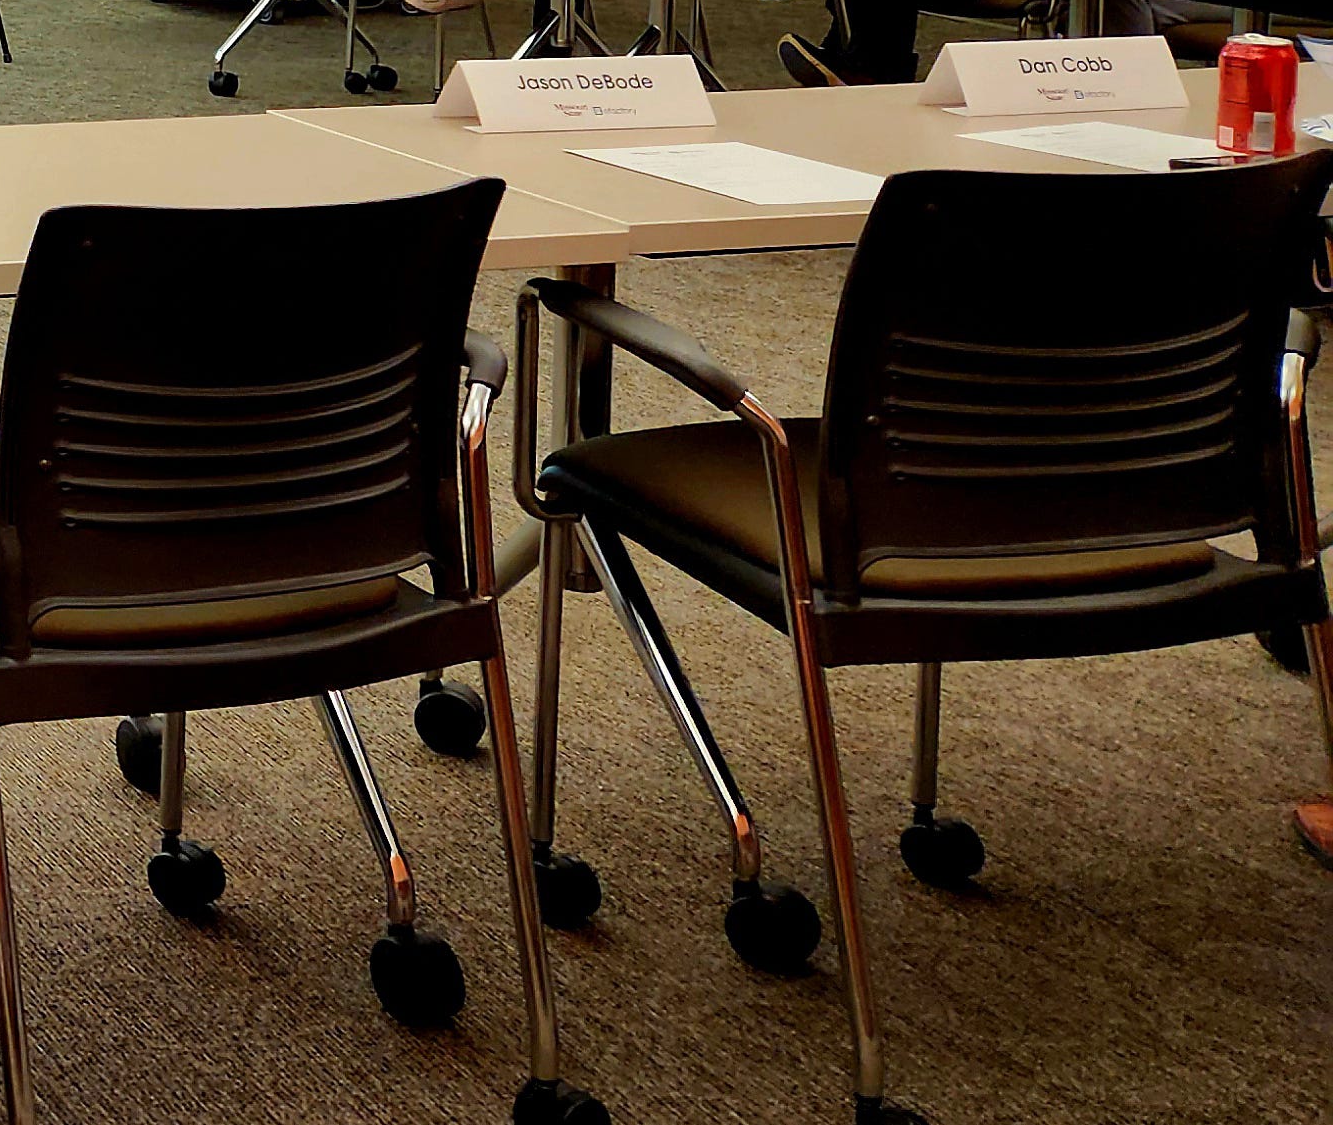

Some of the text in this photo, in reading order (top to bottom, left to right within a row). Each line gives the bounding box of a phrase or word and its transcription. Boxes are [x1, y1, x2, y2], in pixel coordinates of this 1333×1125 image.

[1018, 56, 1113, 74] Dan Cobb
[517, 74, 654, 90] Jason DeBode
